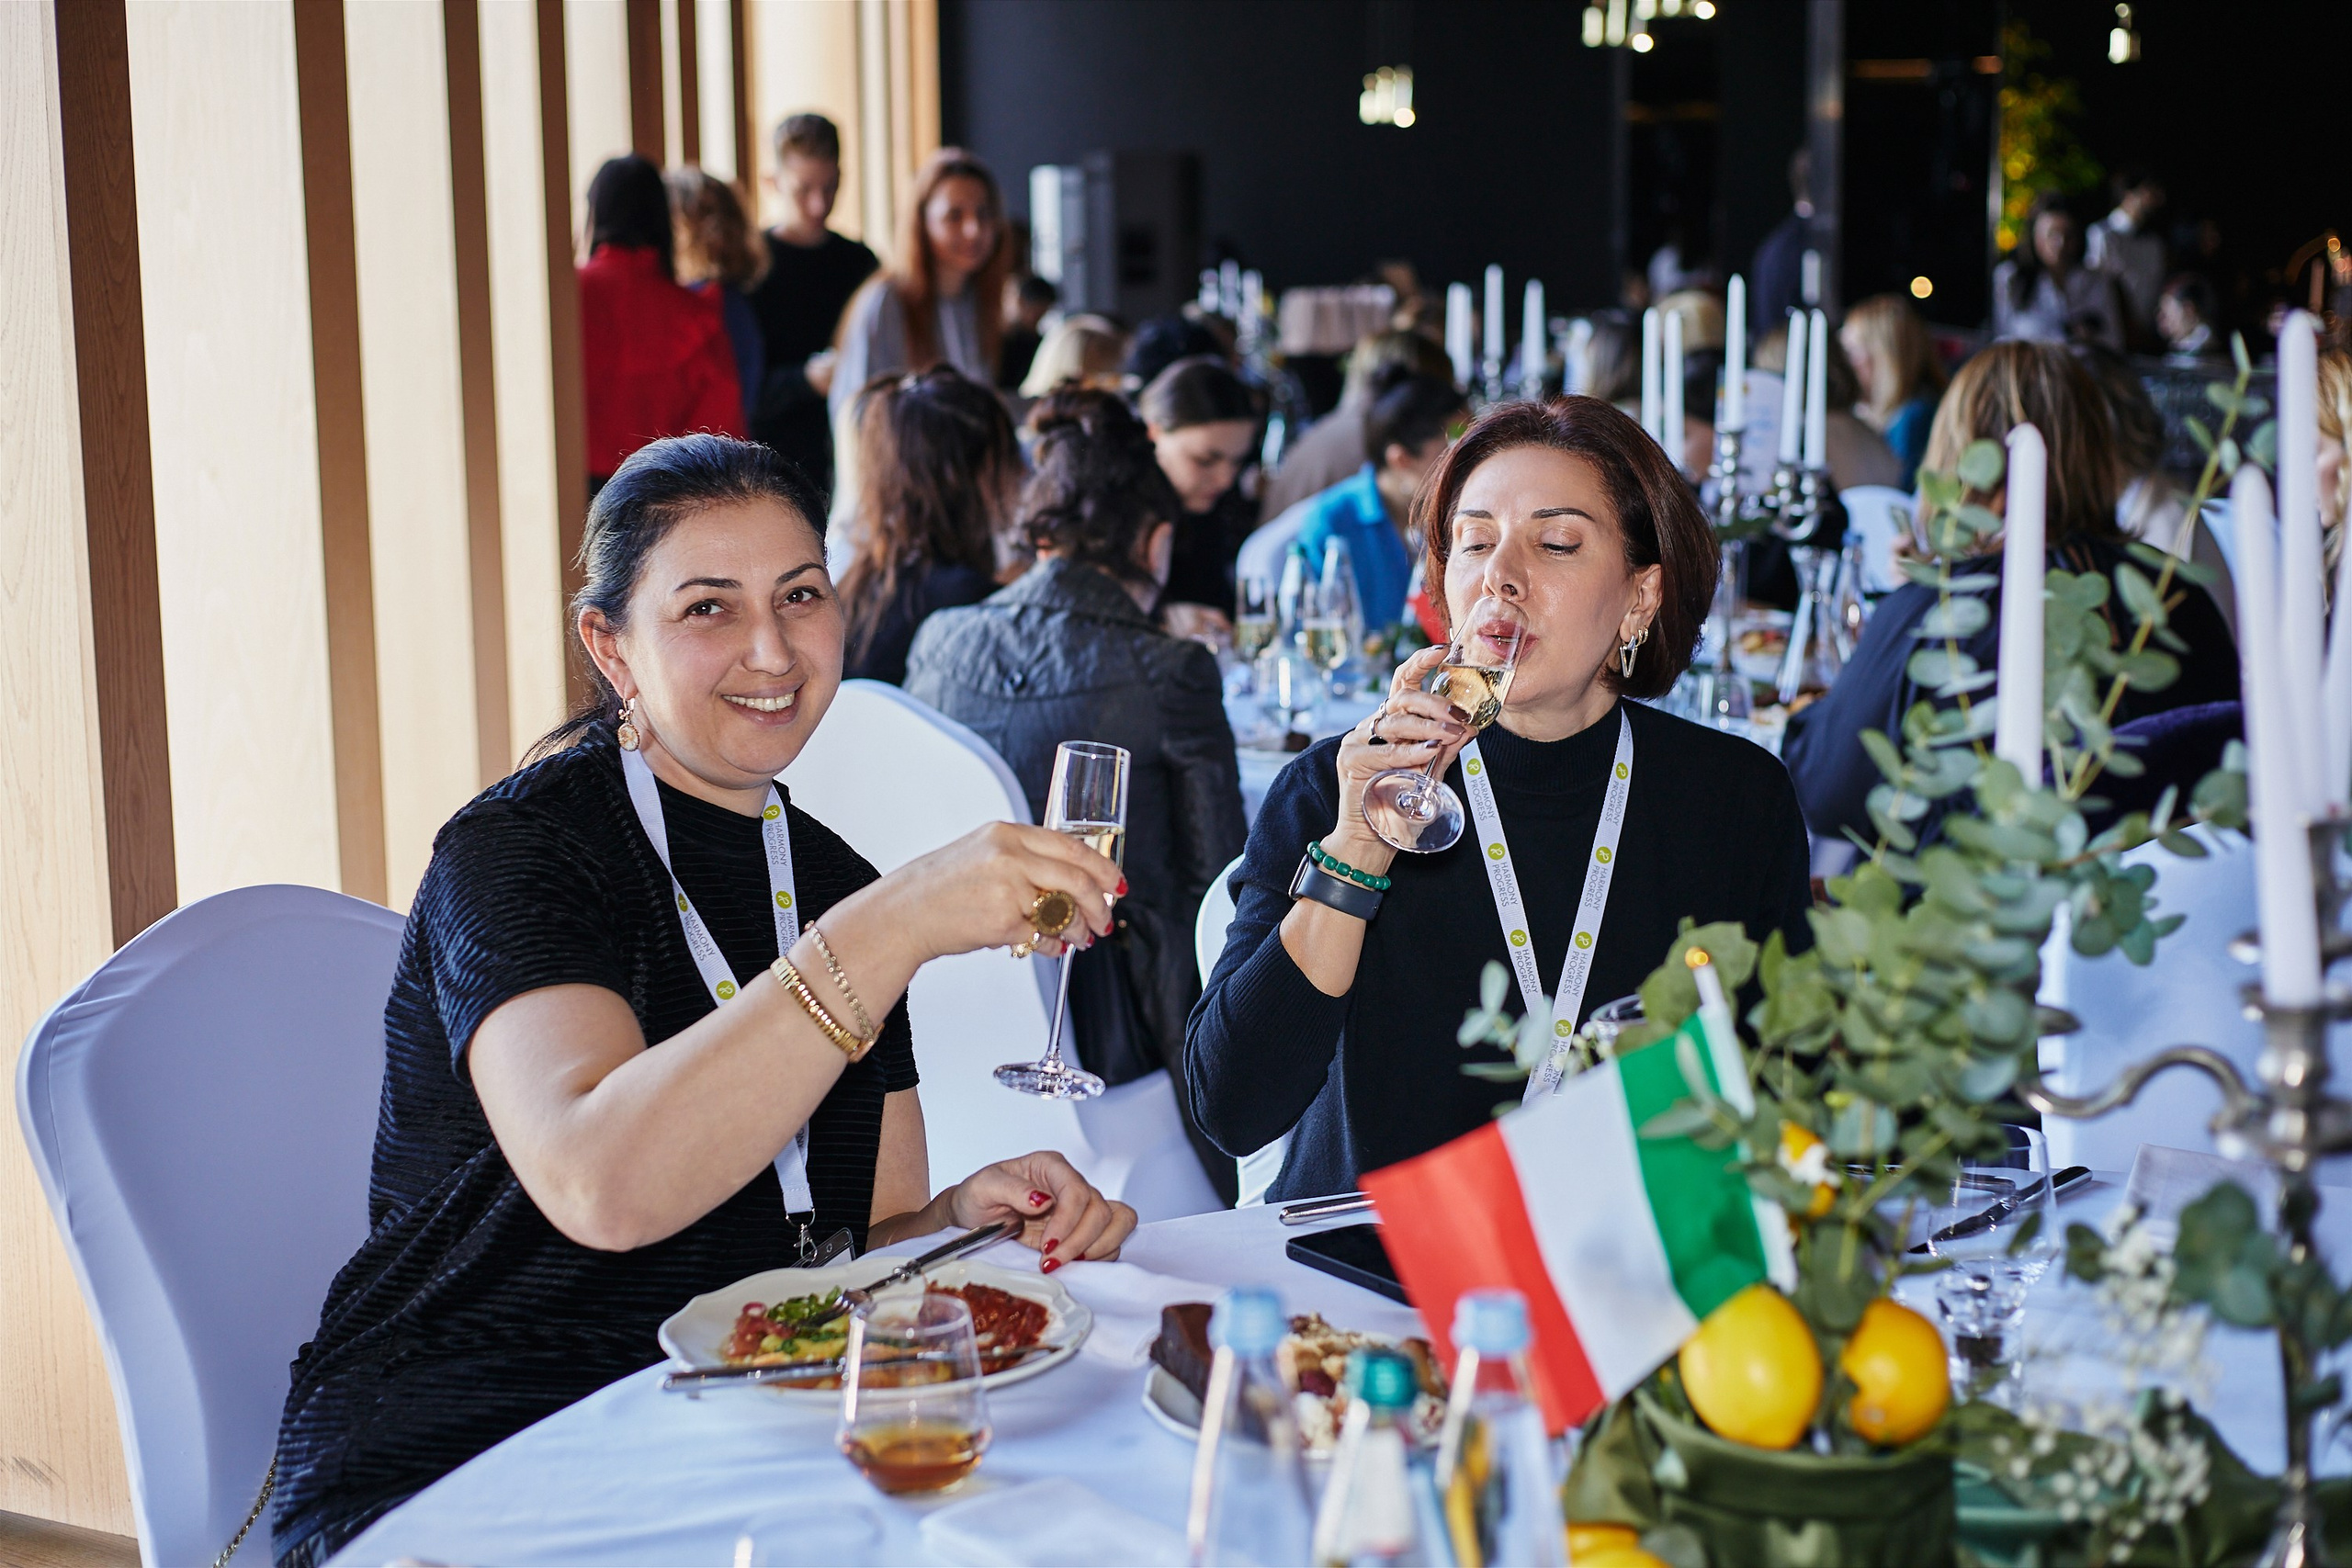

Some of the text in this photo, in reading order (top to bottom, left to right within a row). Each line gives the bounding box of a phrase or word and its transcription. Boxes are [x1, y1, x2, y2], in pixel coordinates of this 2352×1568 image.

[1470, 779, 1487, 821] PROGRESS
[1477, 775, 1496, 819] HARMONY
[1605, 780, 1619, 822] PROGRESS
[1612, 783, 1625, 827] HARMONY
[766, 823, 779, 865] PROGRESS
[775, 821, 787, 866] HARMONY
[1492, 863, 1510, 908] PROGRESS
[1500, 862, 1518, 905] HARMONY
[1584, 864, 1600, 908] PROGRESS
[1592, 867, 1608, 911] HARMONY
[684, 916, 707, 962] PROGRESS
[688, 911, 716, 956] HARMONY
[786, 912, 797, 947] HARMO
[1514, 951, 1532, 994] PROGRESS
[1522, 949, 1539, 993] HARMONY
[1563, 950, 1579, 994] PROGRESS
[1571, 952, 1589, 998] HARMONY
[1551, 1040, 1567, 1085] HAONY
